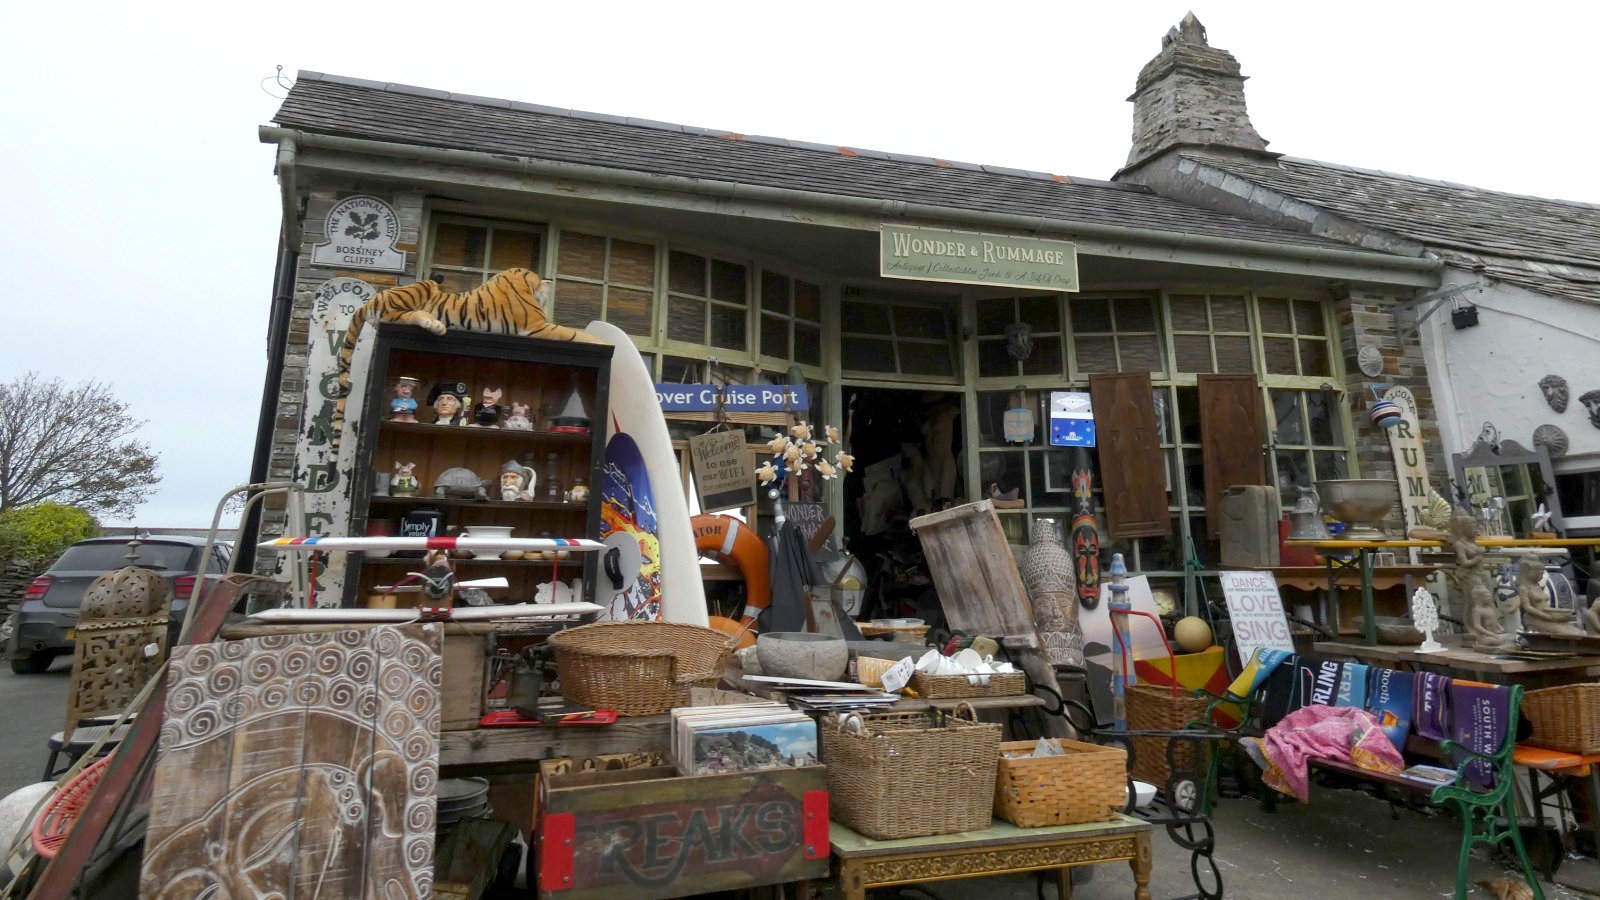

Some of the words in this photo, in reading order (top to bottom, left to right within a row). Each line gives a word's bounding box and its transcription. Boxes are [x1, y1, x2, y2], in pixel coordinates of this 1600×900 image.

[330, 217, 340, 235] THE
[336, 200, 384, 216] NATIONAL
[383, 212, 396, 239] TRUST
[336, 246, 385, 257] BOSSINEY
[892, 231, 966, 258] WONDER
[970, 245, 979, 257] &
[982, 240, 1064, 265] RUMMAGE
[343, 256, 375, 265] CLIFFS
[887, 261, 924, 272] Antiques
[933, 262, 977, 275] Collectables
[978, 267, 1001, 280] Junk
[1015, 271, 1028, 280] A
[317, 282, 370, 313] WELCOM
[340, 304, 355, 314] TO
[656, 391, 693, 404] over
[700, 389, 756, 405] Cruise
[762, 390, 799, 405] Port
[720, 459, 737, 467] use
[785, 504, 825, 521] WONDER
[404, 520, 430, 532] Simply
[693, 526, 721, 538] TOR
[1231, 577, 1268, 588] DANCE
[1229, 594, 1281, 612] LOVE
[1235, 620, 1289, 641] SING
[1312, 661, 1339, 705] RLING
[1379, 669, 1392, 704] mooth
[1482, 699, 1492, 739] SOUTH
